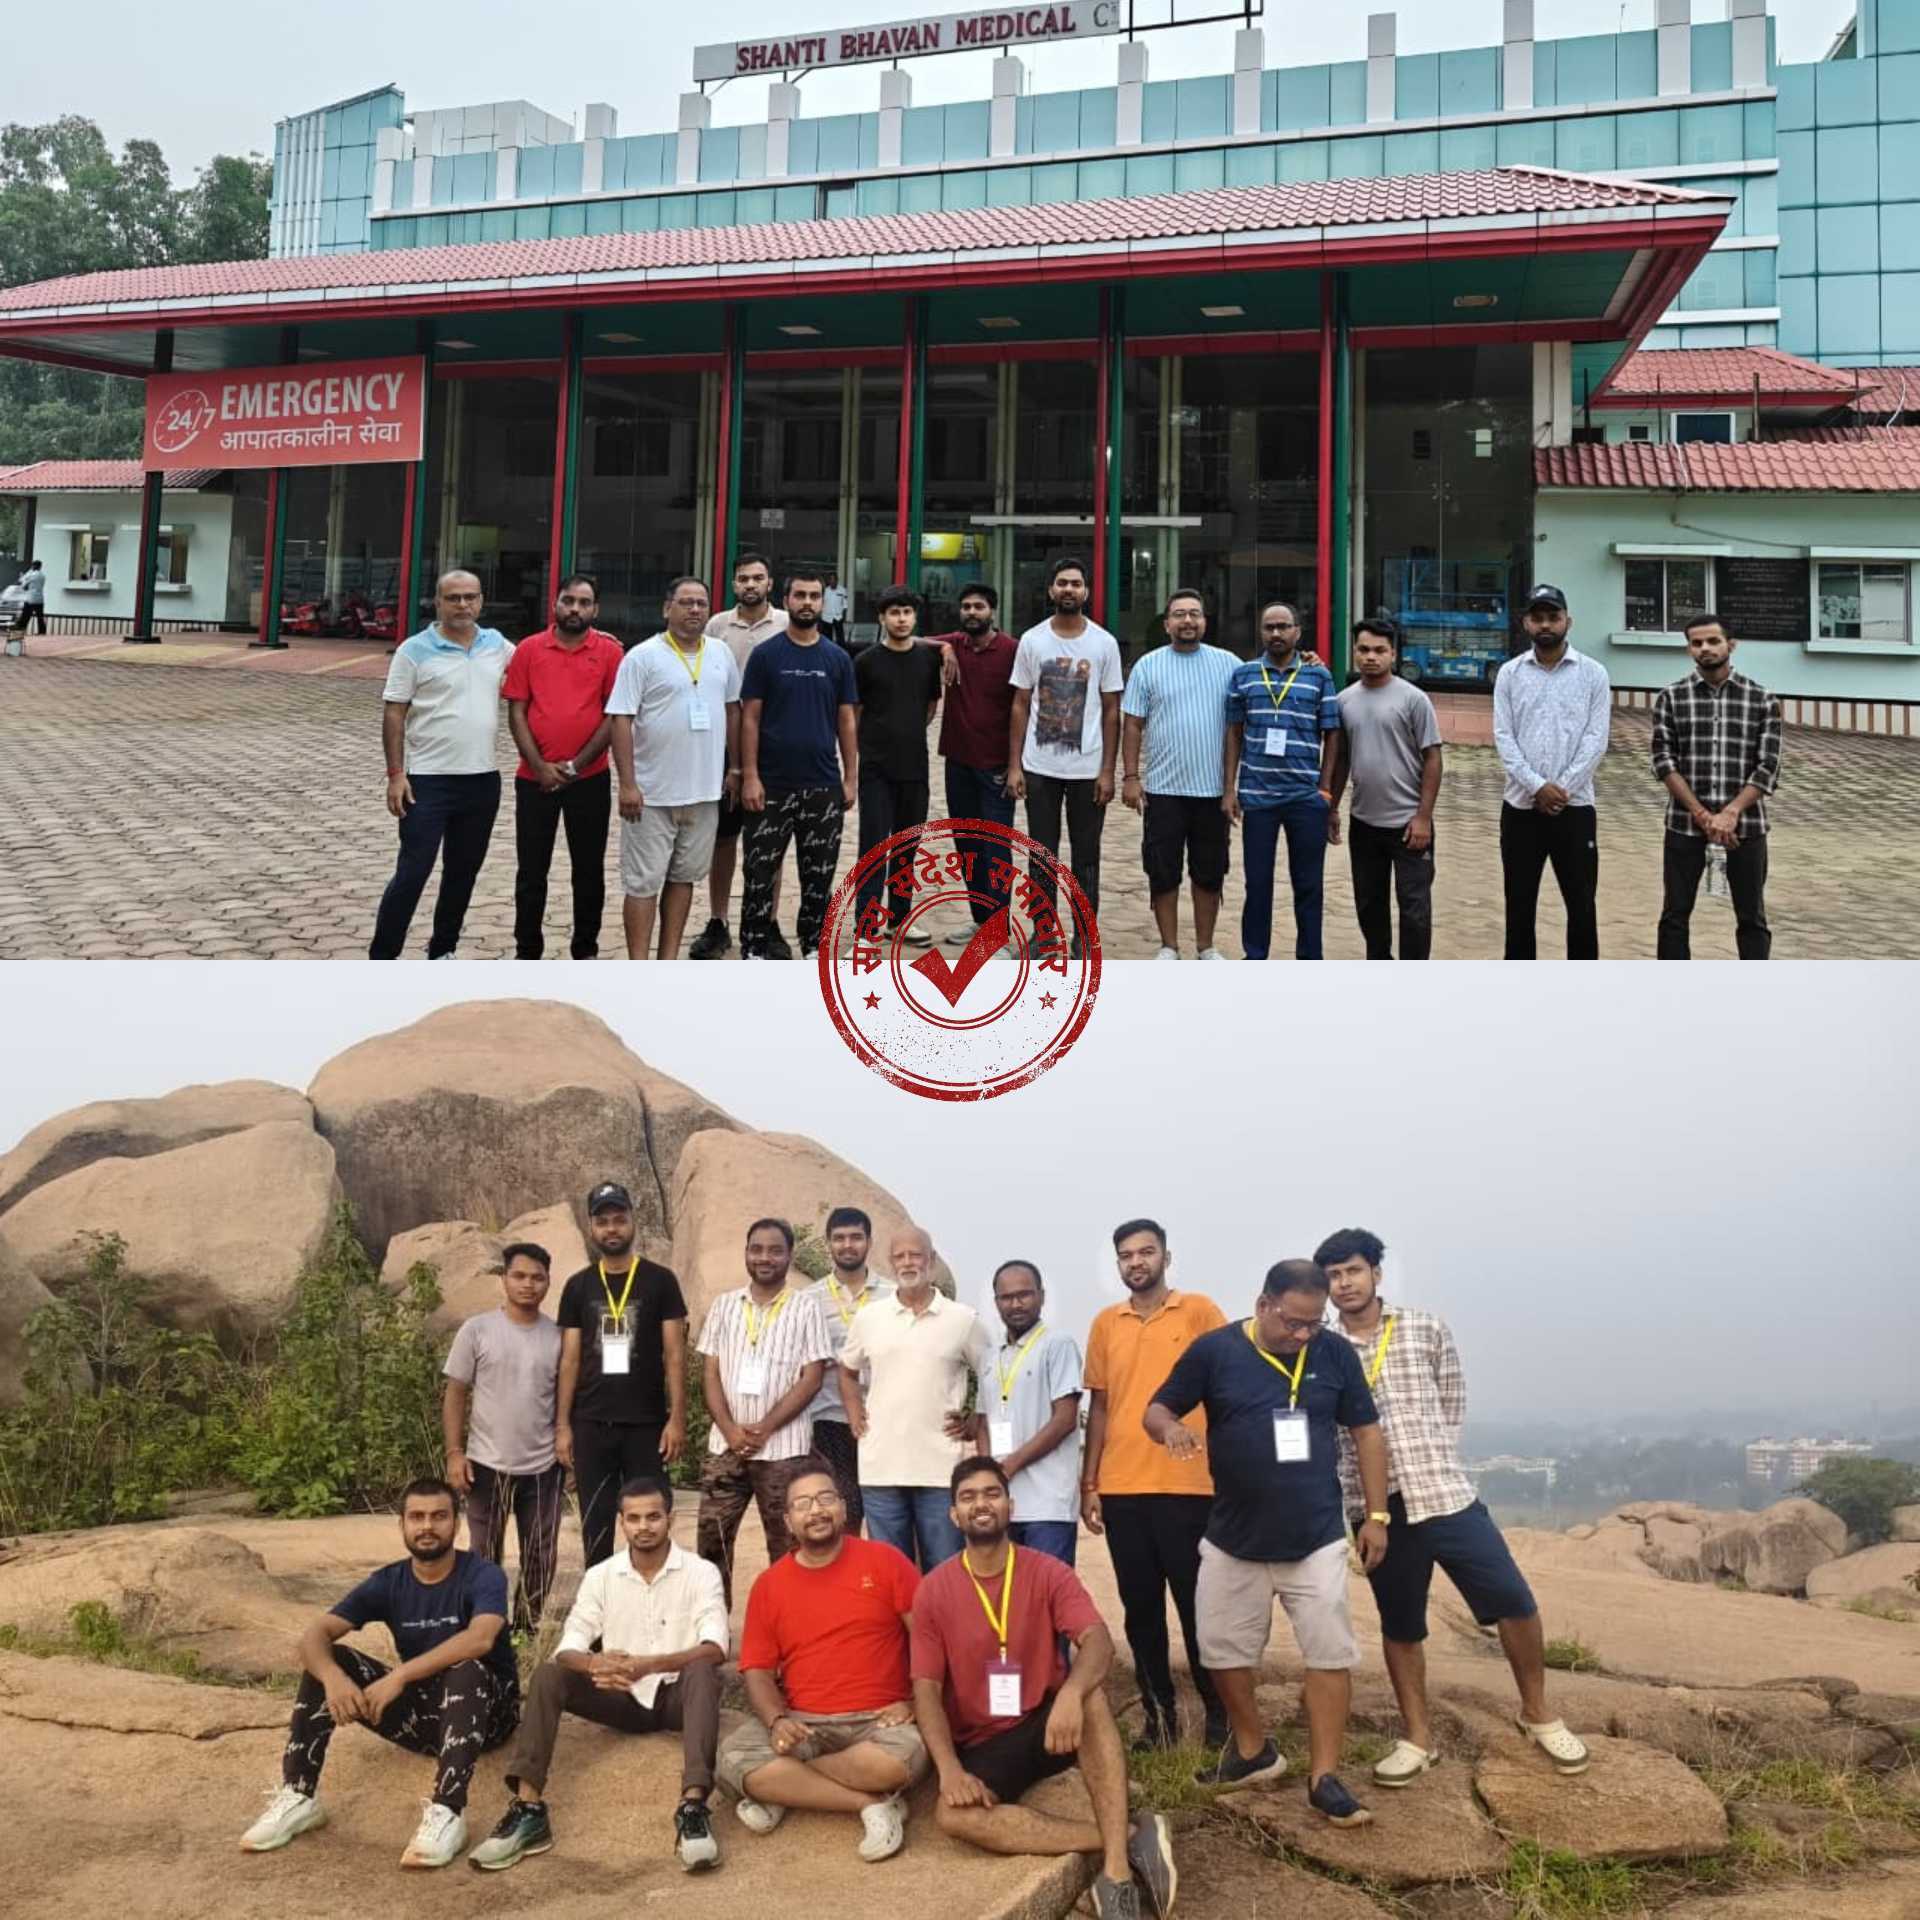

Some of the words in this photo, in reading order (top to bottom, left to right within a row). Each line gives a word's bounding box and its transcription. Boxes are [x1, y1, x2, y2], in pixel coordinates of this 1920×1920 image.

[736, 38, 826, 72] SHANTI
[840, 22, 940, 60] BHAVAN
[956, 7, 1076, 45] MEDICAL
[167, 407, 217, 432] 24/7
[220, 372, 405, 421] EMERGENCY
[219, 418, 353, 450] आपातकालीन
[359, 416, 403, 444] सेवा
